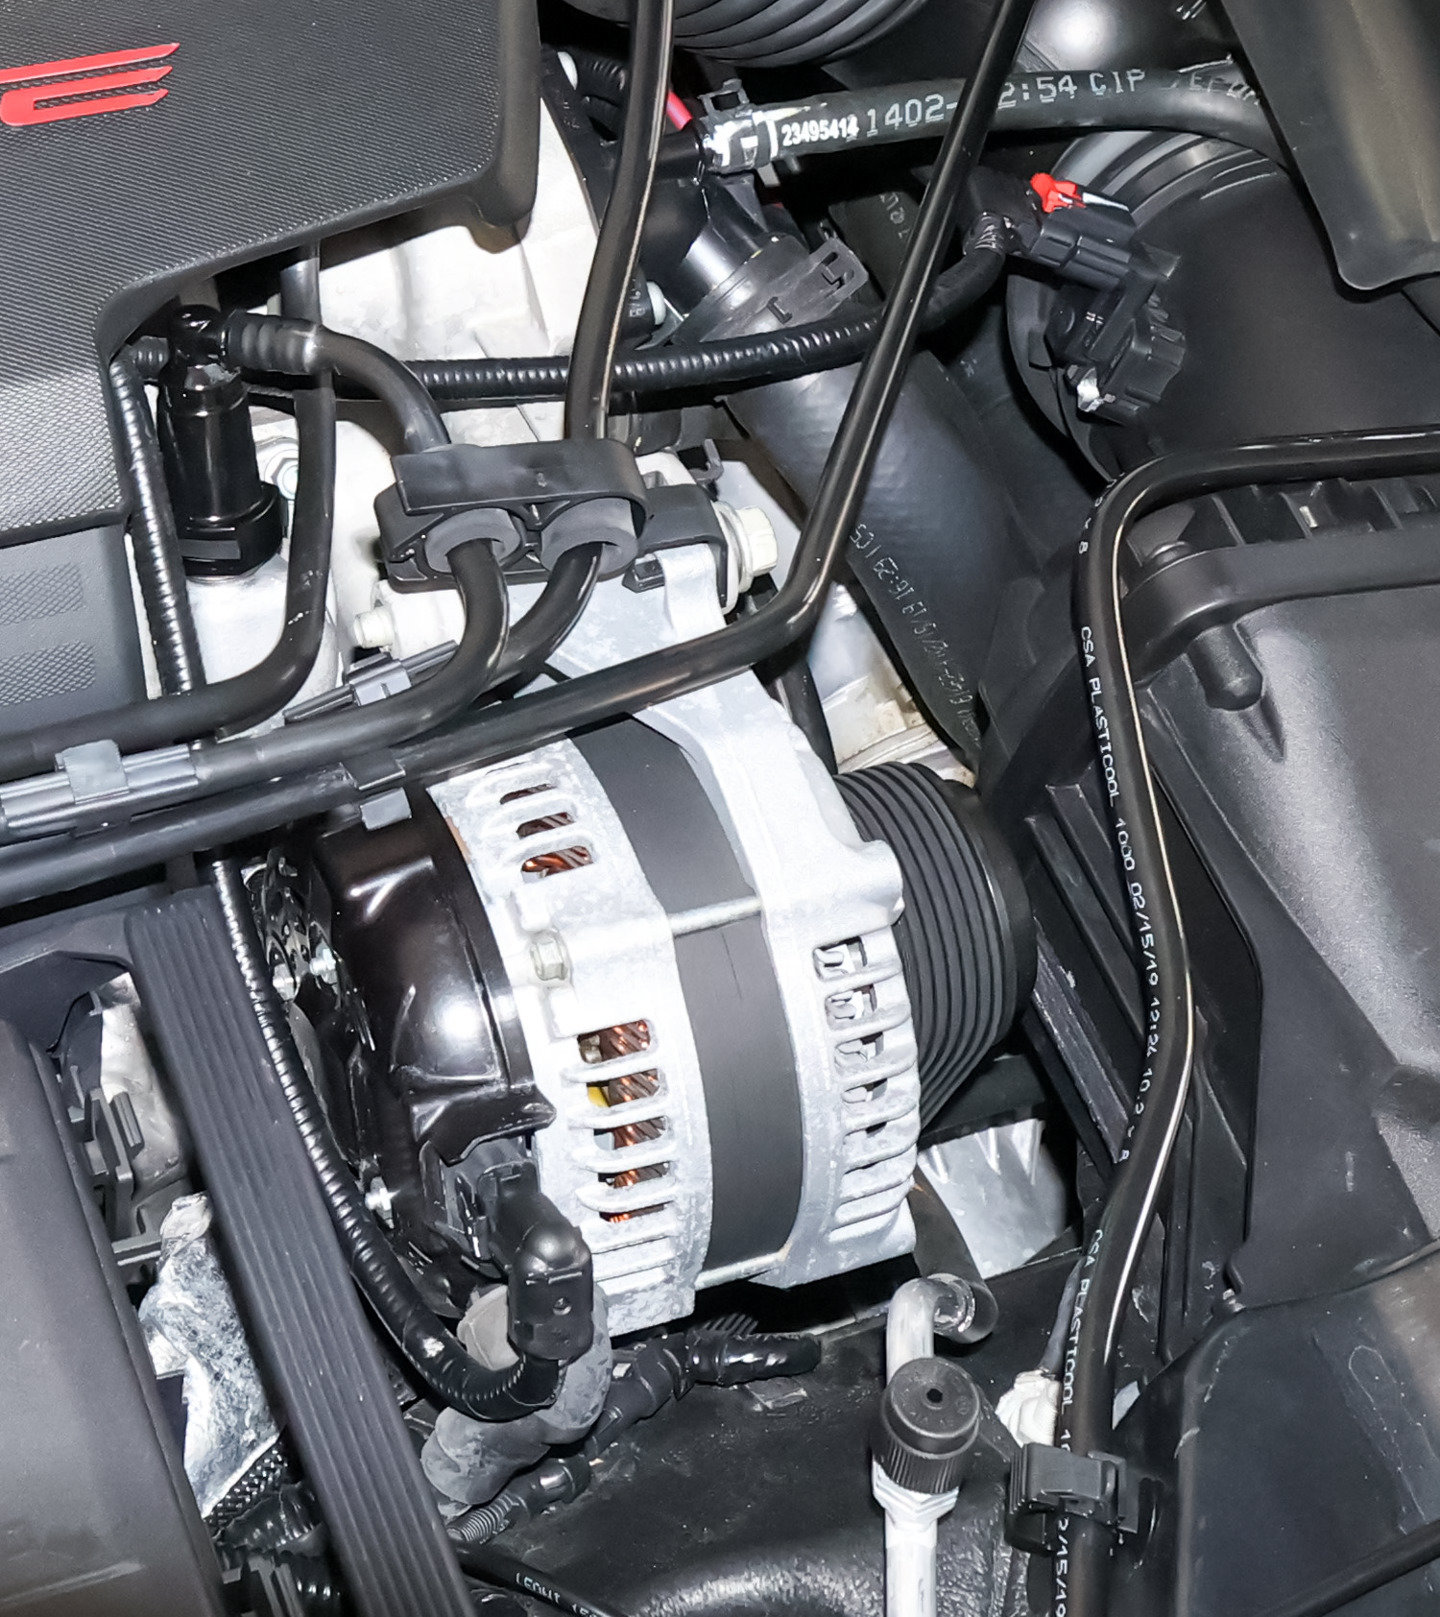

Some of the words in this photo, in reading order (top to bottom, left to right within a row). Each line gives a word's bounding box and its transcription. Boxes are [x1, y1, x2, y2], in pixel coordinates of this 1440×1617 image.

[781, 114, 861, 147] 23495414
[1080, 625, 1096, 668] CSA
[1088, 676, 1120, 808] PLASTICOOL
[1115, 817, 1136, 872] 1000
[1128, 881, 1160, 987] 02/15/19
[1061, 1277, 1091, 1415] PLASTICOOL
